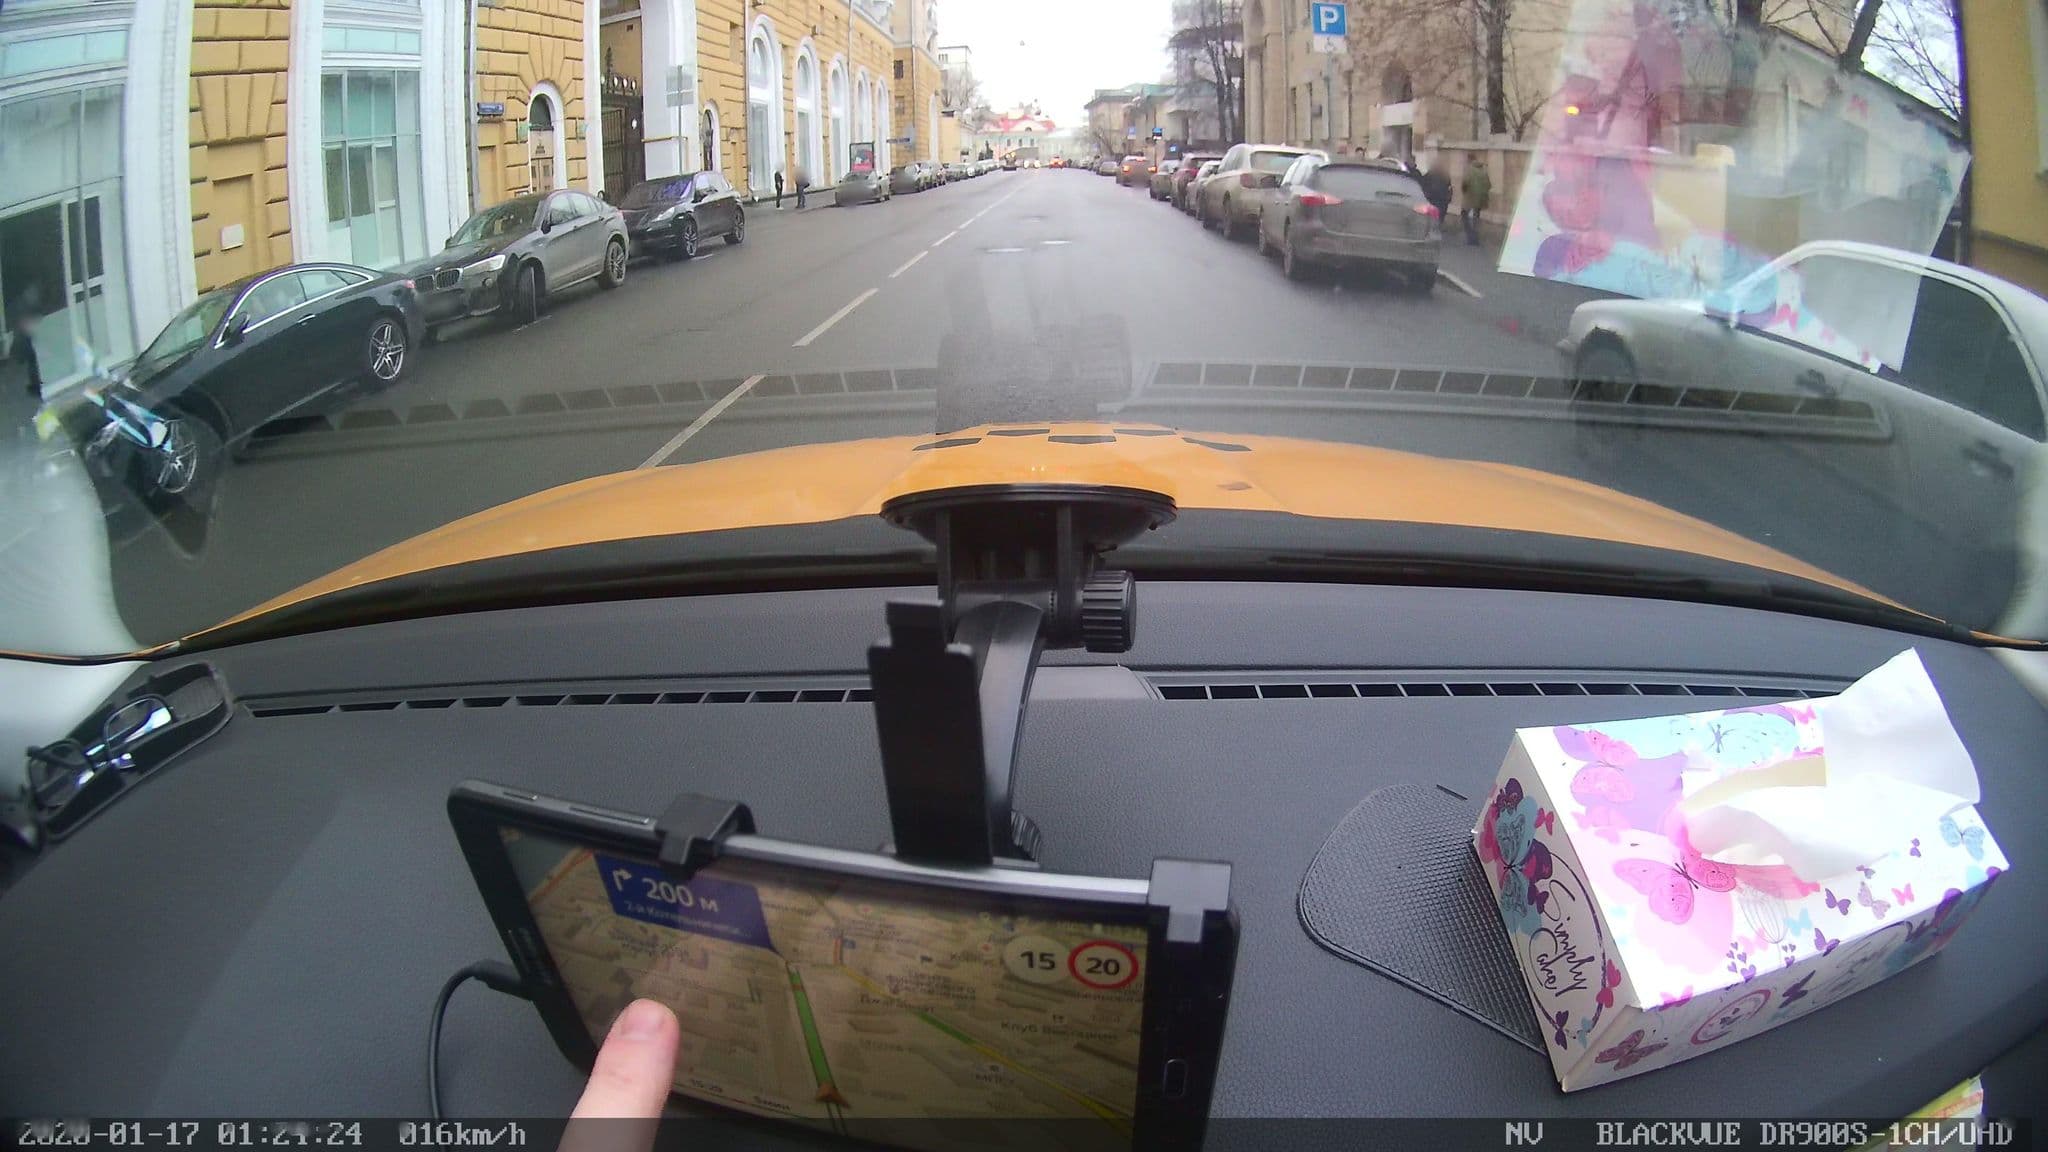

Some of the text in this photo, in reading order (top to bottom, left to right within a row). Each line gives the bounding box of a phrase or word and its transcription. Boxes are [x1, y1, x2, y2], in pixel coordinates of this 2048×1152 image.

[1320, 6, 1339, 31] P
[642, 877, 694, 907] 200
[1538, 879, 1595, 997] Simply
[1020, 950, 1056, 970] 15
[1085, 957, 1120, 976] 20
